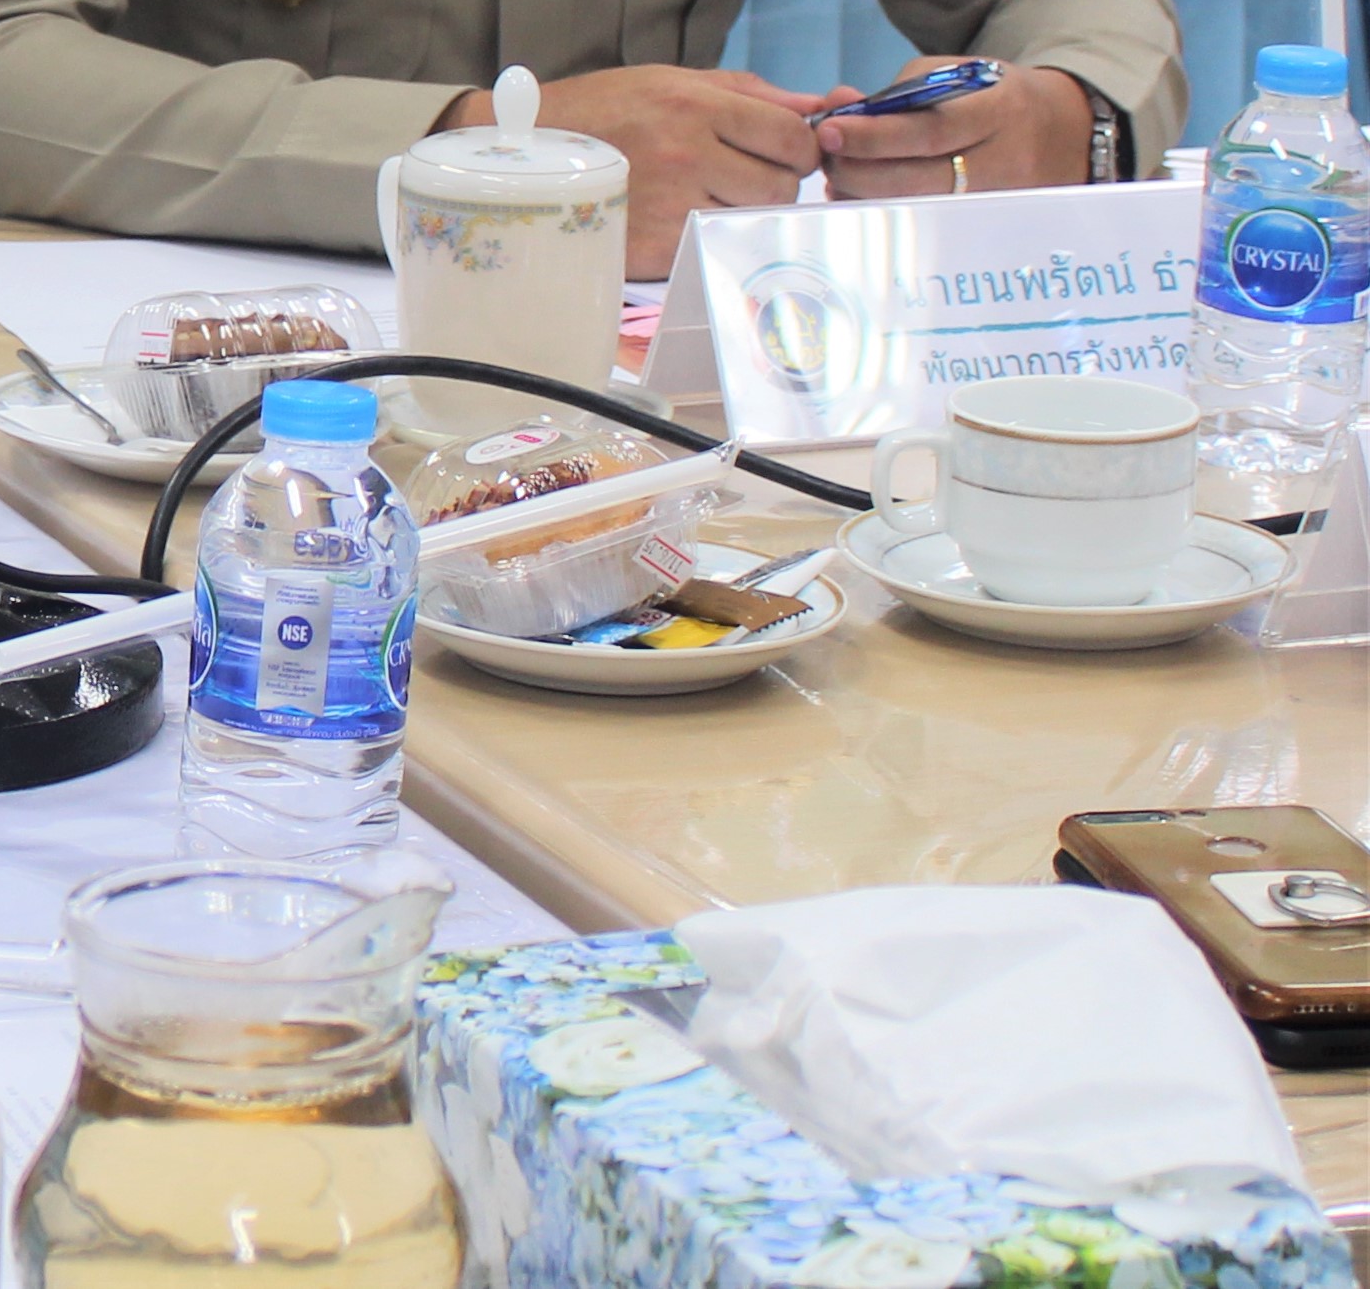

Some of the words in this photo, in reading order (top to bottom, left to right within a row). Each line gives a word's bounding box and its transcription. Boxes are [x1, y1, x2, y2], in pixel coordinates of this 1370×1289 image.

[895, 250, 1137, 308] นายนพรัตน์
[1233, 243, 1322, 272] CRYSTAL
